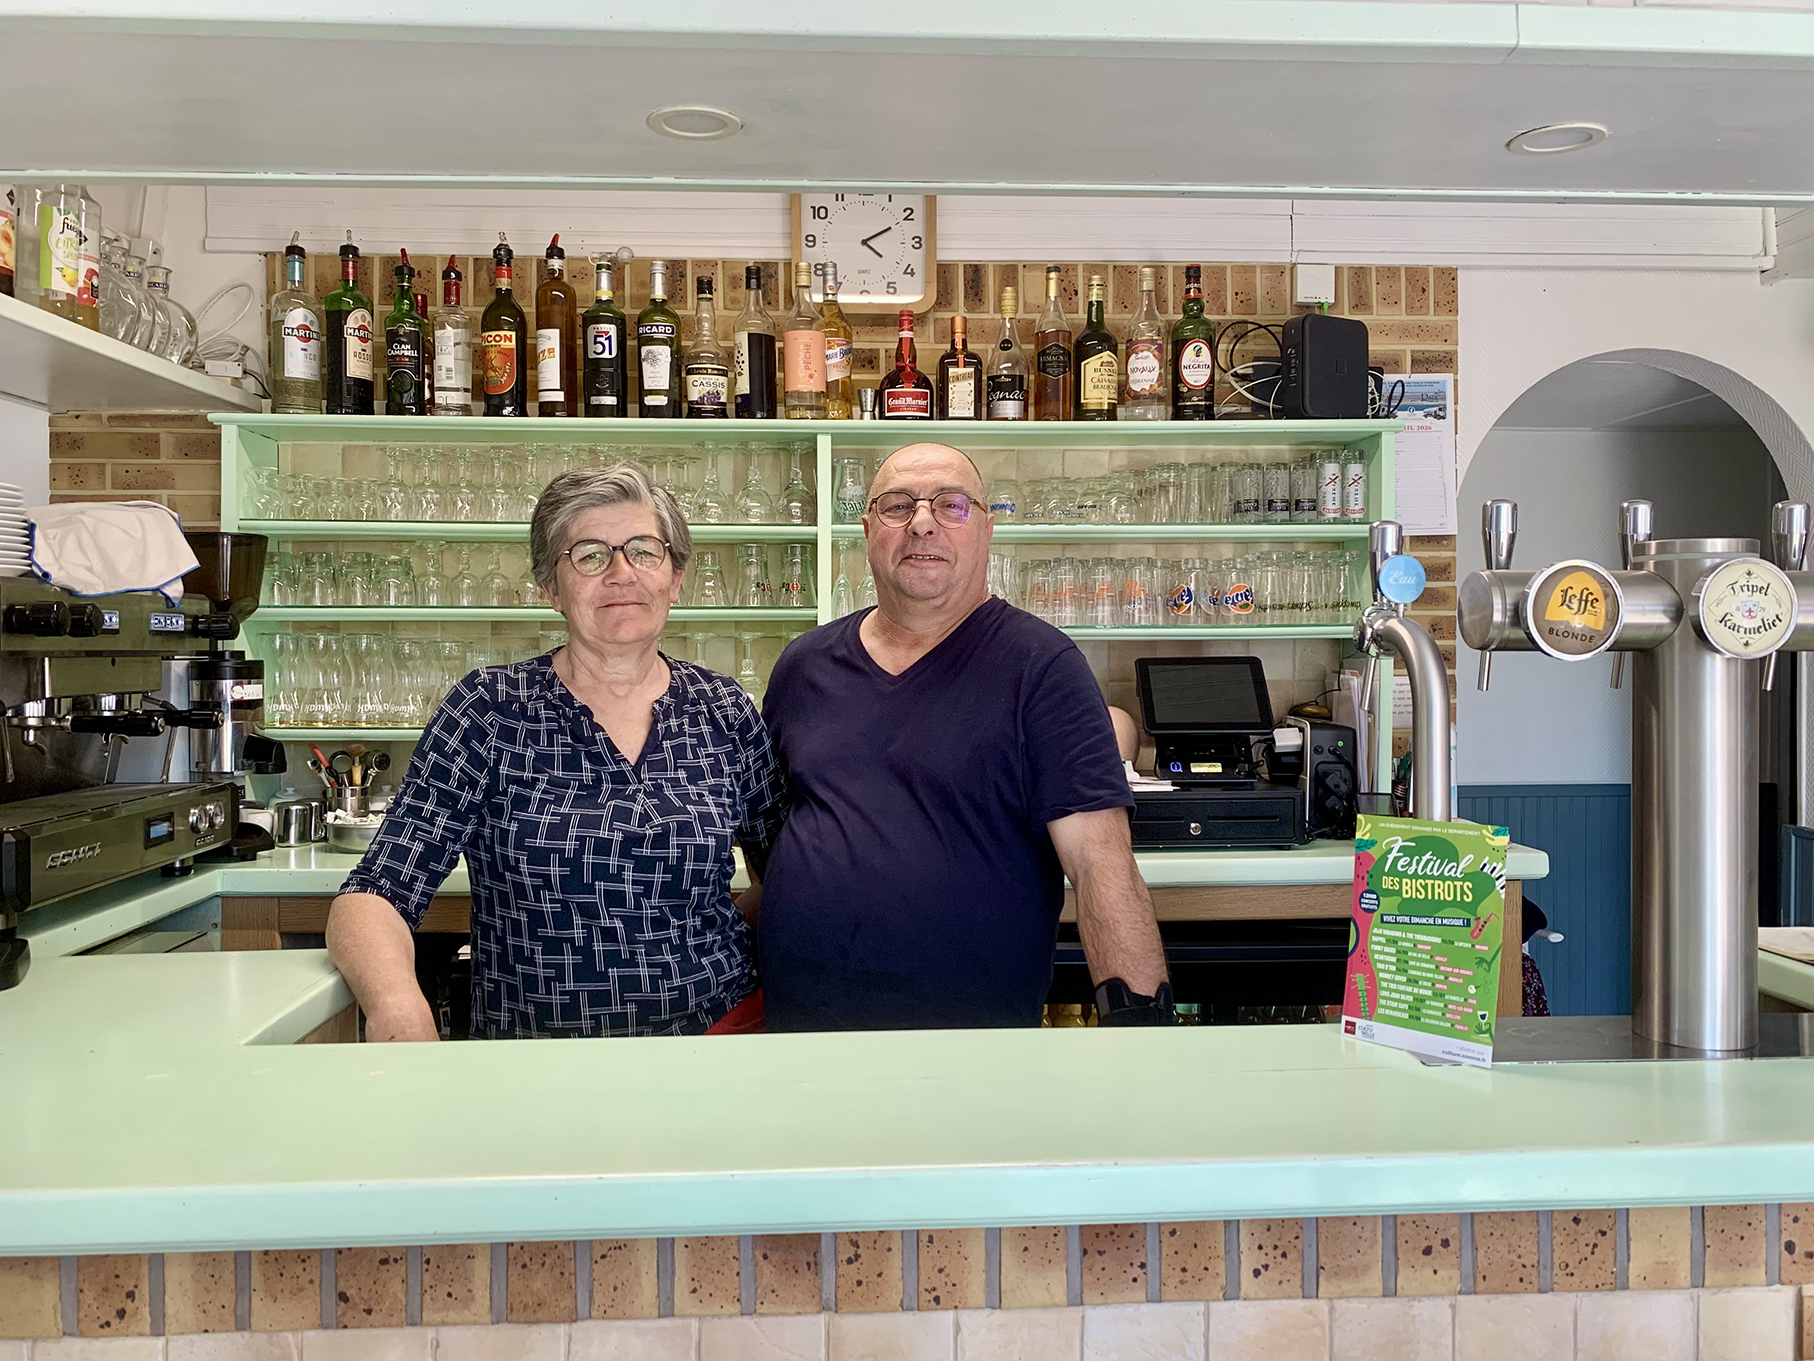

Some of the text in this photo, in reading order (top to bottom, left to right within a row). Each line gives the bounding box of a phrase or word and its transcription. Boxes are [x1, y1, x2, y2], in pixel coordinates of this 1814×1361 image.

[810, 206, 828, 220] 10
[902, 207, 914, 221] 2
[804, 234, 816, 248] 9
[911, 236, 922, 250] 3
[814, 262, 824, 277] 8
[902, 264, 916, 277] 4
[886, 282, 898, 295] 5
[638, 326, 673, 334] RICARD
[387, 348, 418, 356] CAMPBELL
[592, 334, 613, 356] 51
[353, 350, 372, 362] ROSSO
[802, 342, 812, 370] PÊCHE
[1130, 366, 1156, 374] NOYAUX
[692, 380, 726, 388] CASSIS
[1388, 571, 1418, 585] Eau
[1726, 580, 1772, 597] Tripel
[1558, 586, 1600, 616] Leffe
[1716, 612, 1783, 635] Karmeliet
[1548, 626, 1596, 644] BLONDE
[1382, 836, 1474, 878] Festival
[1382, 876, 1473, 902] DES BISTROTS
